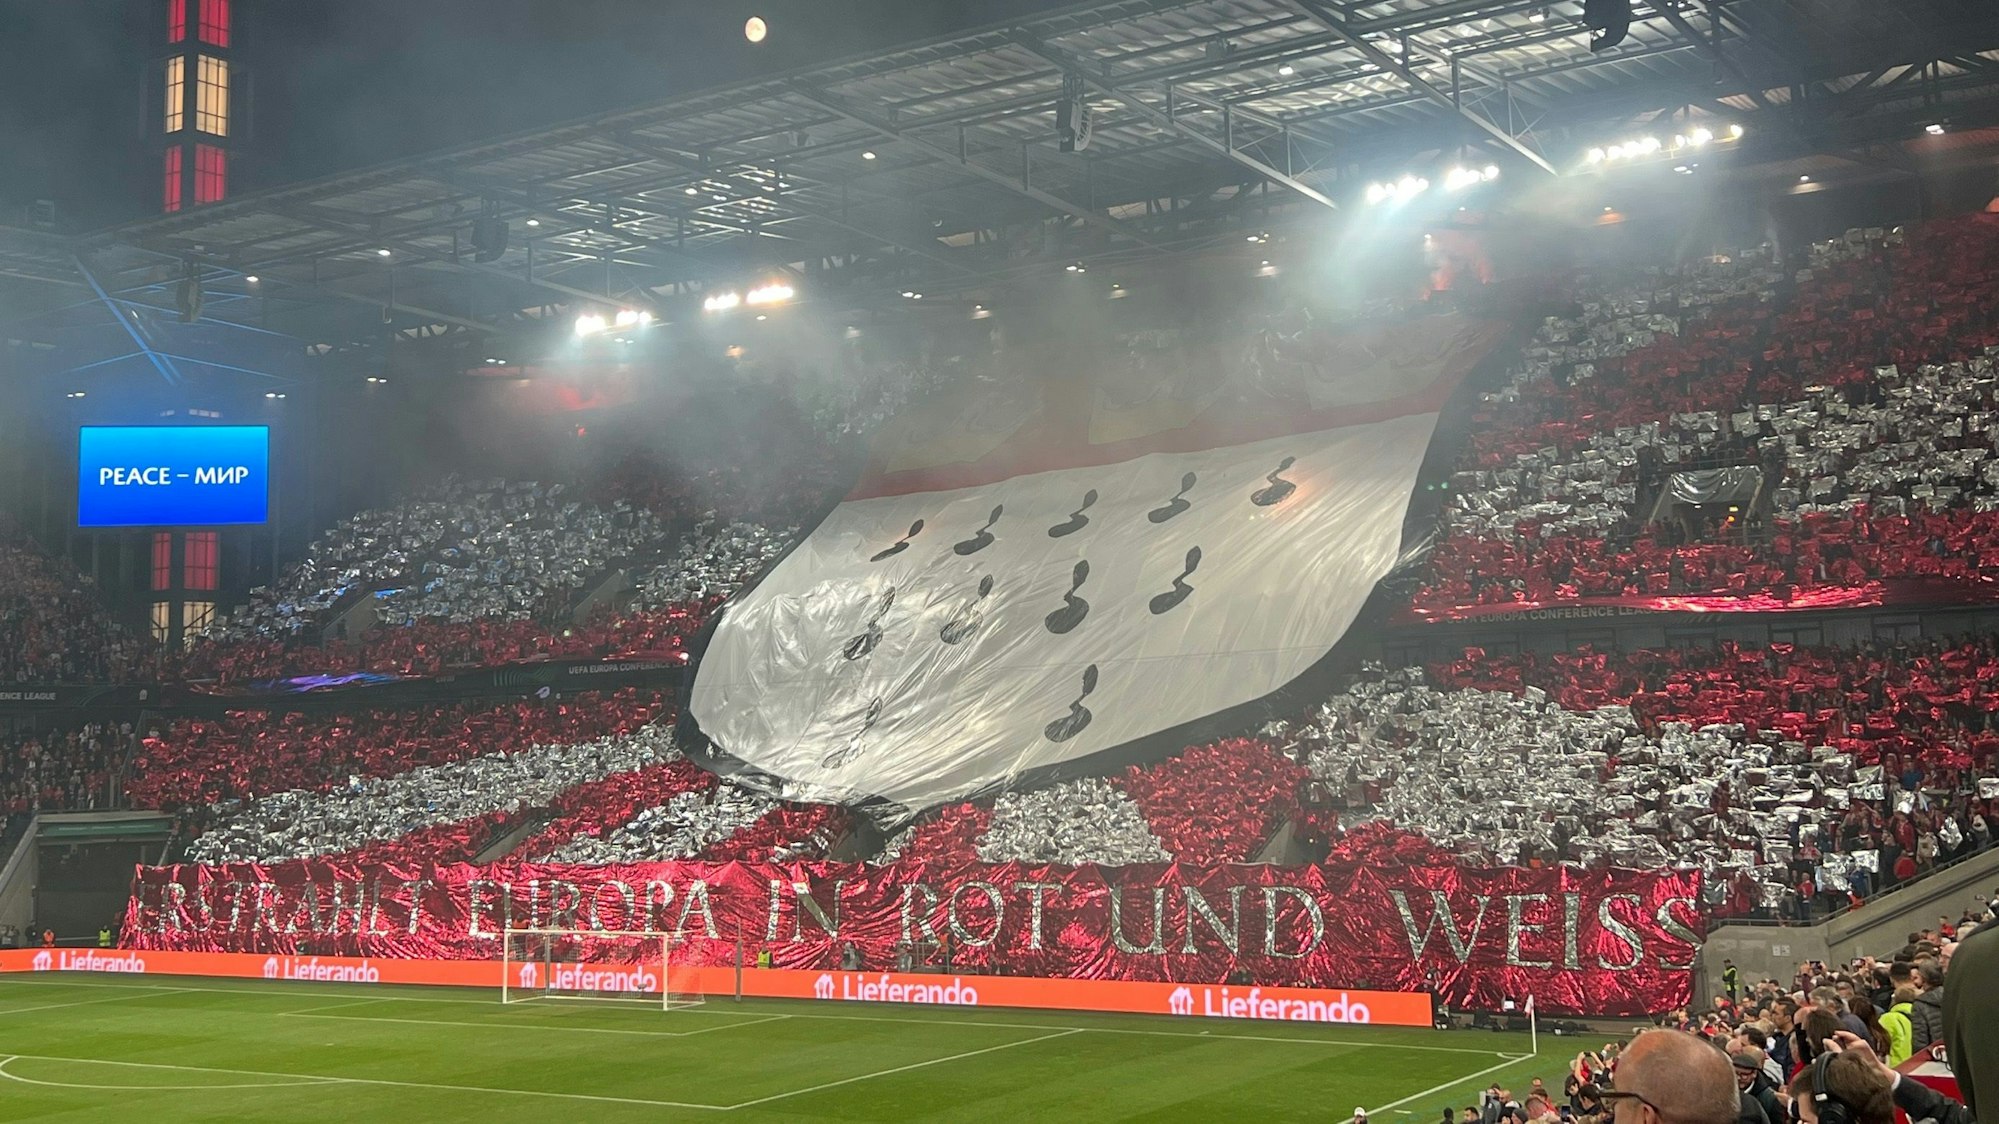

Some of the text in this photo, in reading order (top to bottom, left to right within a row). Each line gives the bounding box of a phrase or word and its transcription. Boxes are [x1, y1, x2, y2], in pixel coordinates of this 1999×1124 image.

[100, 467, 171, 486] PEACE
[195, 466, 249, 485] МИР
[1480, 611, 1528, 623] EUROPA
[1530, 606, 1614, 620] CONFERENCE
[569, 666, 588, 675] UEFA
[590, 664, 618, 673] EUROPA
[24, 692, 56, 701] LEAGUE
[467, 879, 722, 942] EUROPA
[765, 879, 848, 943] IN
[901, 881, 1064, 949] ROT
[1109, 884, 1325, 959] UND
[1389, 889, 1704, 972] WEISS
[60, 950, 145, 973] Lieferando
[284, 957, 379, 983] Lieferando
[844, 973, 978, 1005] Lieferando
[1204, 987, 1370, 1024] Lieferando
